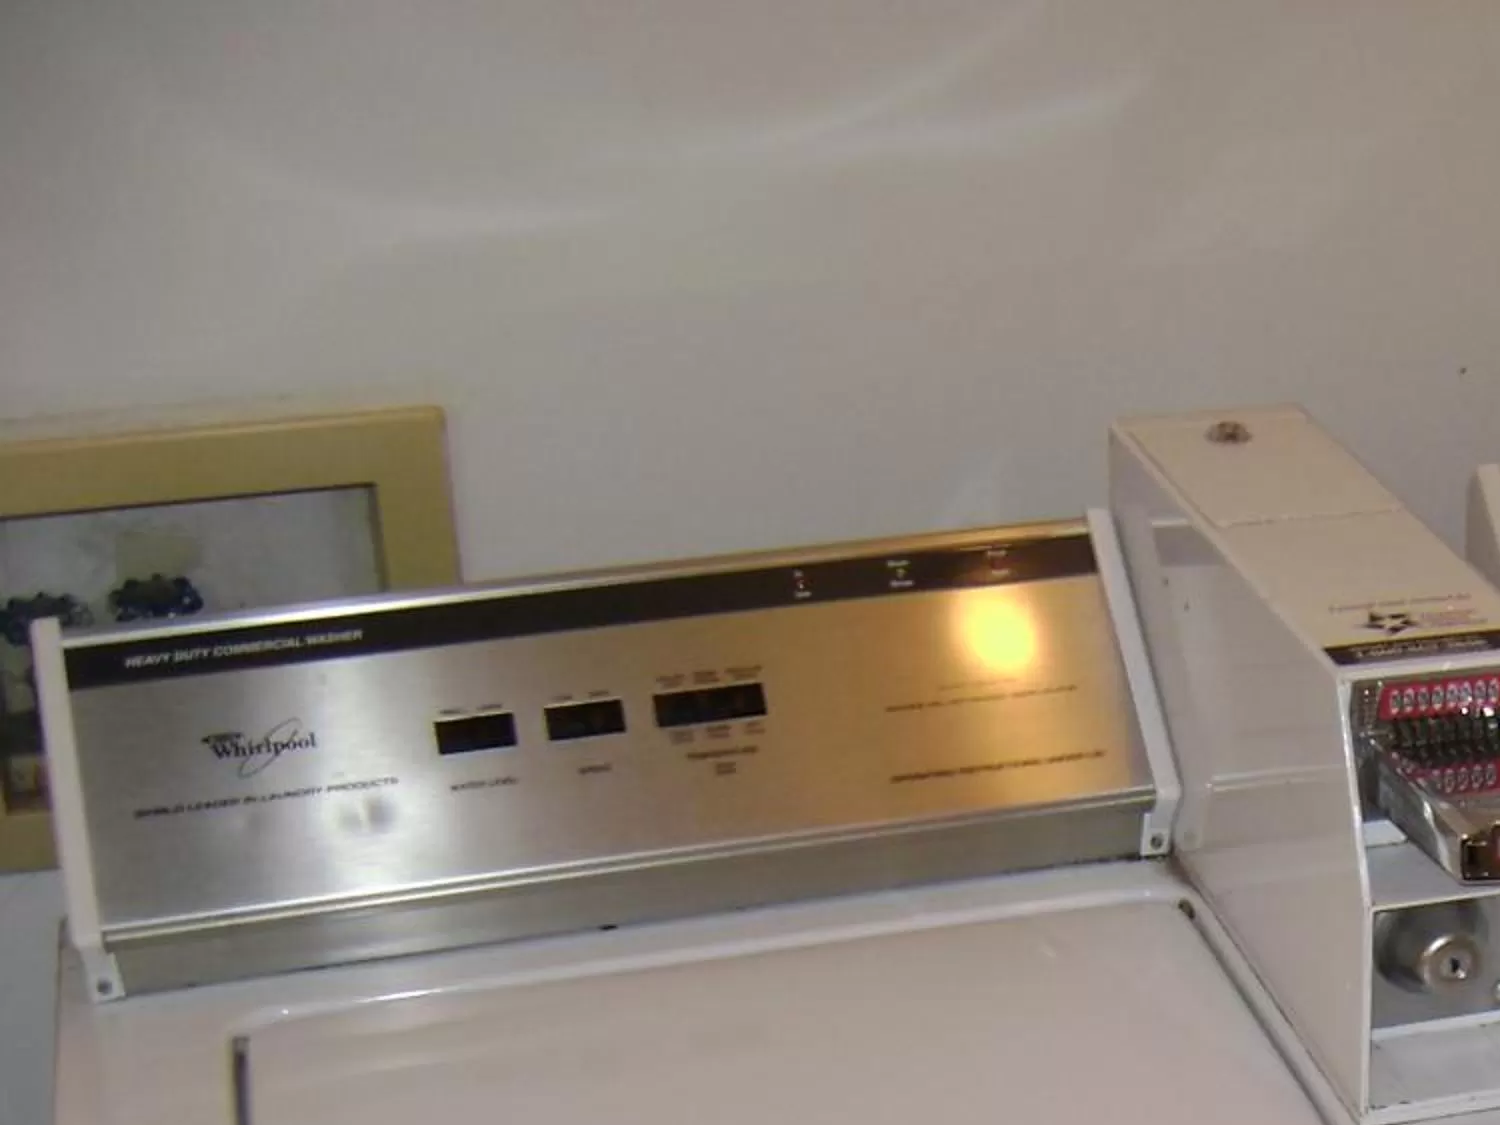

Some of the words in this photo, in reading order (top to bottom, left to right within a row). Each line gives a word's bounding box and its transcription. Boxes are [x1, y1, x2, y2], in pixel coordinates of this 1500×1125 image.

[125, 652, 173, 669] HEAVY
[175, 649, 210, 663] DUTY
[212, 637, 302, 657] COMMERCIAL
[305, 628, 364, 646] WASHER
[208, 731, 318, 762] Whirlpool
[261, 785, 323, 802] LAUNDRY
[326, 775, 400, 793] PRODUCTS
